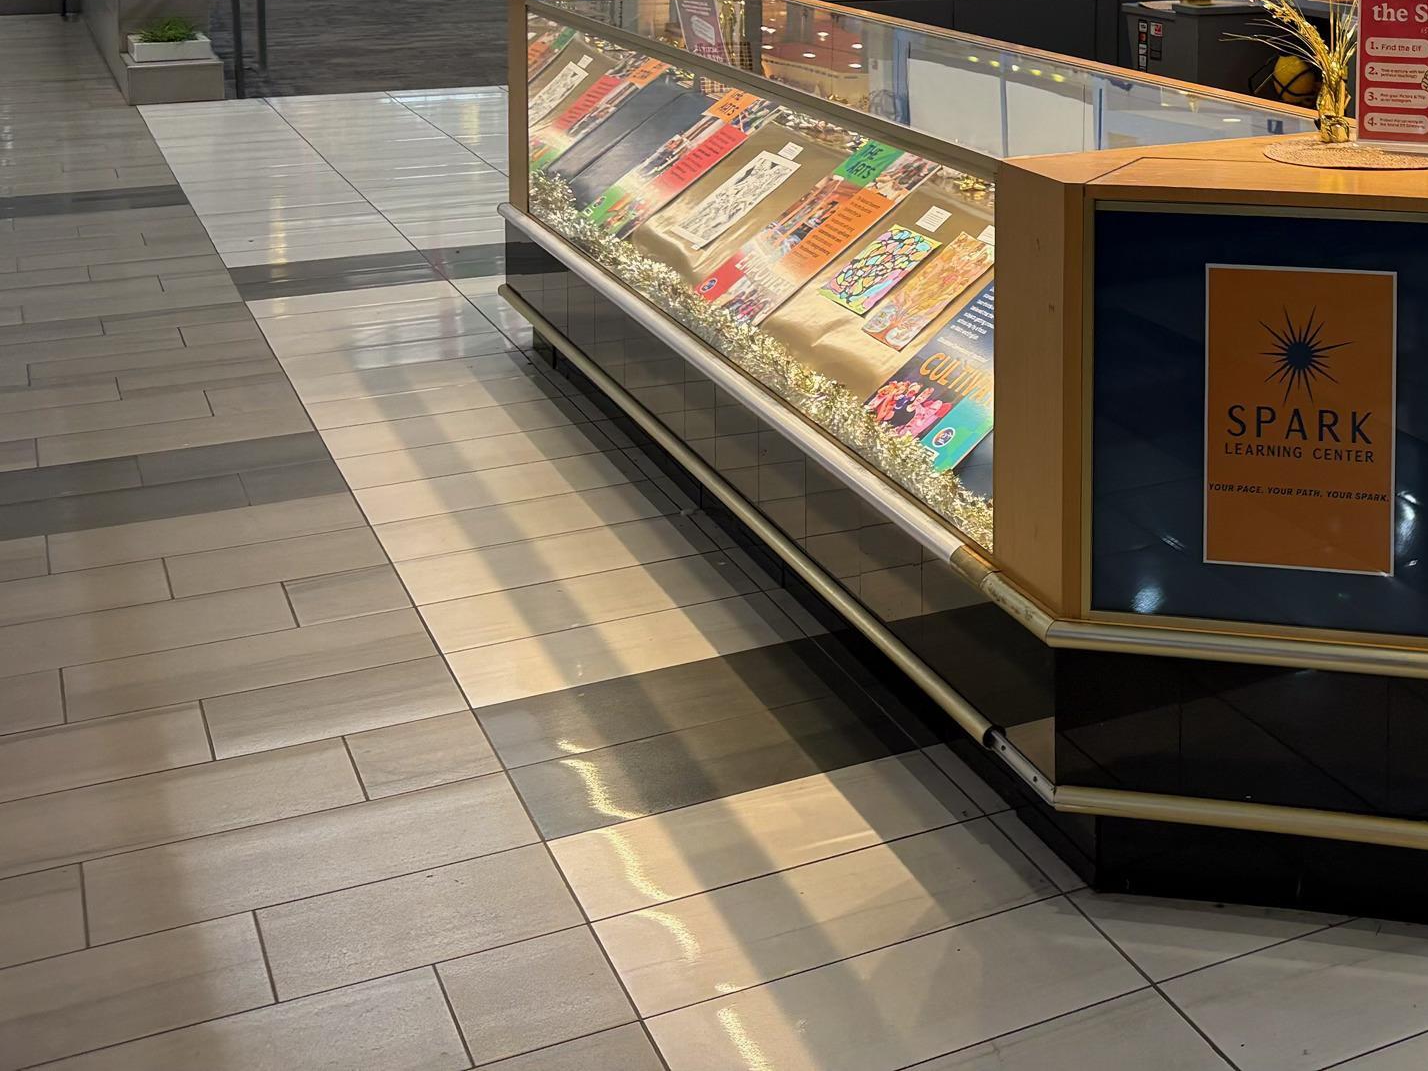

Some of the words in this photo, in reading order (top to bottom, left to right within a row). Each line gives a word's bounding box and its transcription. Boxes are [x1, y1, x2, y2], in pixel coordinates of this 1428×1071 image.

[1372, 3, 1409, 22] the
[1370, 41, 1379, 50] 1.
[1368, 66, 1378, 75] 2.
[1367, 91, 1378, 101] 3.
[1367, 117, 1378, 127] 4.
[860, 144, 883, 160] THE
[845, 160, 876, 179] ARTS
[919, 352, 993, 402] CULTIVA
[1227, 405, 1372, 444] SPARK
[1225, 443, 1302, 459] LEARNING
[1313, 448, 1375, 463] CENTER
[1209, 483, 1234, 492] YOUR
[1268, 487, 1293, 496] YOUR
[1327, 490, 1352, 500] YOUR
[1355, 492, 1390, 502] SPARK.
